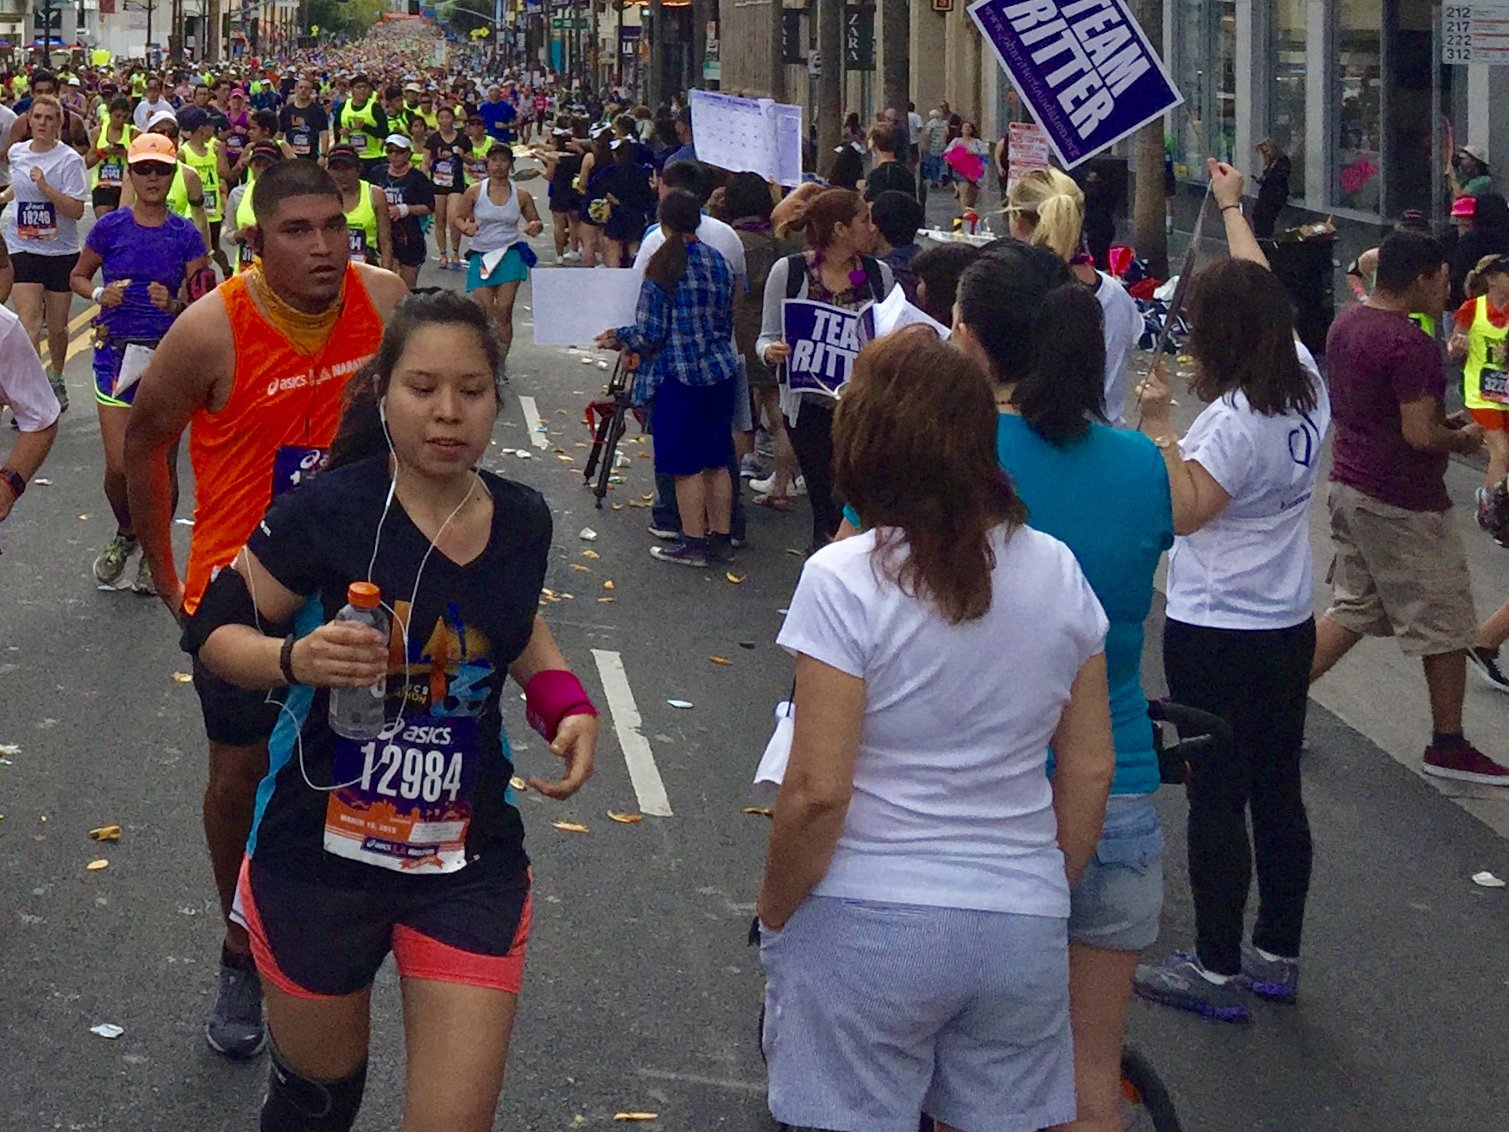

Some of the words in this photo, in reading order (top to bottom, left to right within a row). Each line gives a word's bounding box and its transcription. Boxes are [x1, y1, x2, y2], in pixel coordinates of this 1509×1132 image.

[1446, 7, 1471, 19] 212
[1446, 21, 1470, 32] 217
[847, 13, 859, 61] ZARA
[1447, 35, 1471, 46] 222
[1447, 49, 1470, 59] 312
[280, 375, 308, 390] asics
[403, 725, 452, 745] asics
[360, 741, 463, 802] 12984
